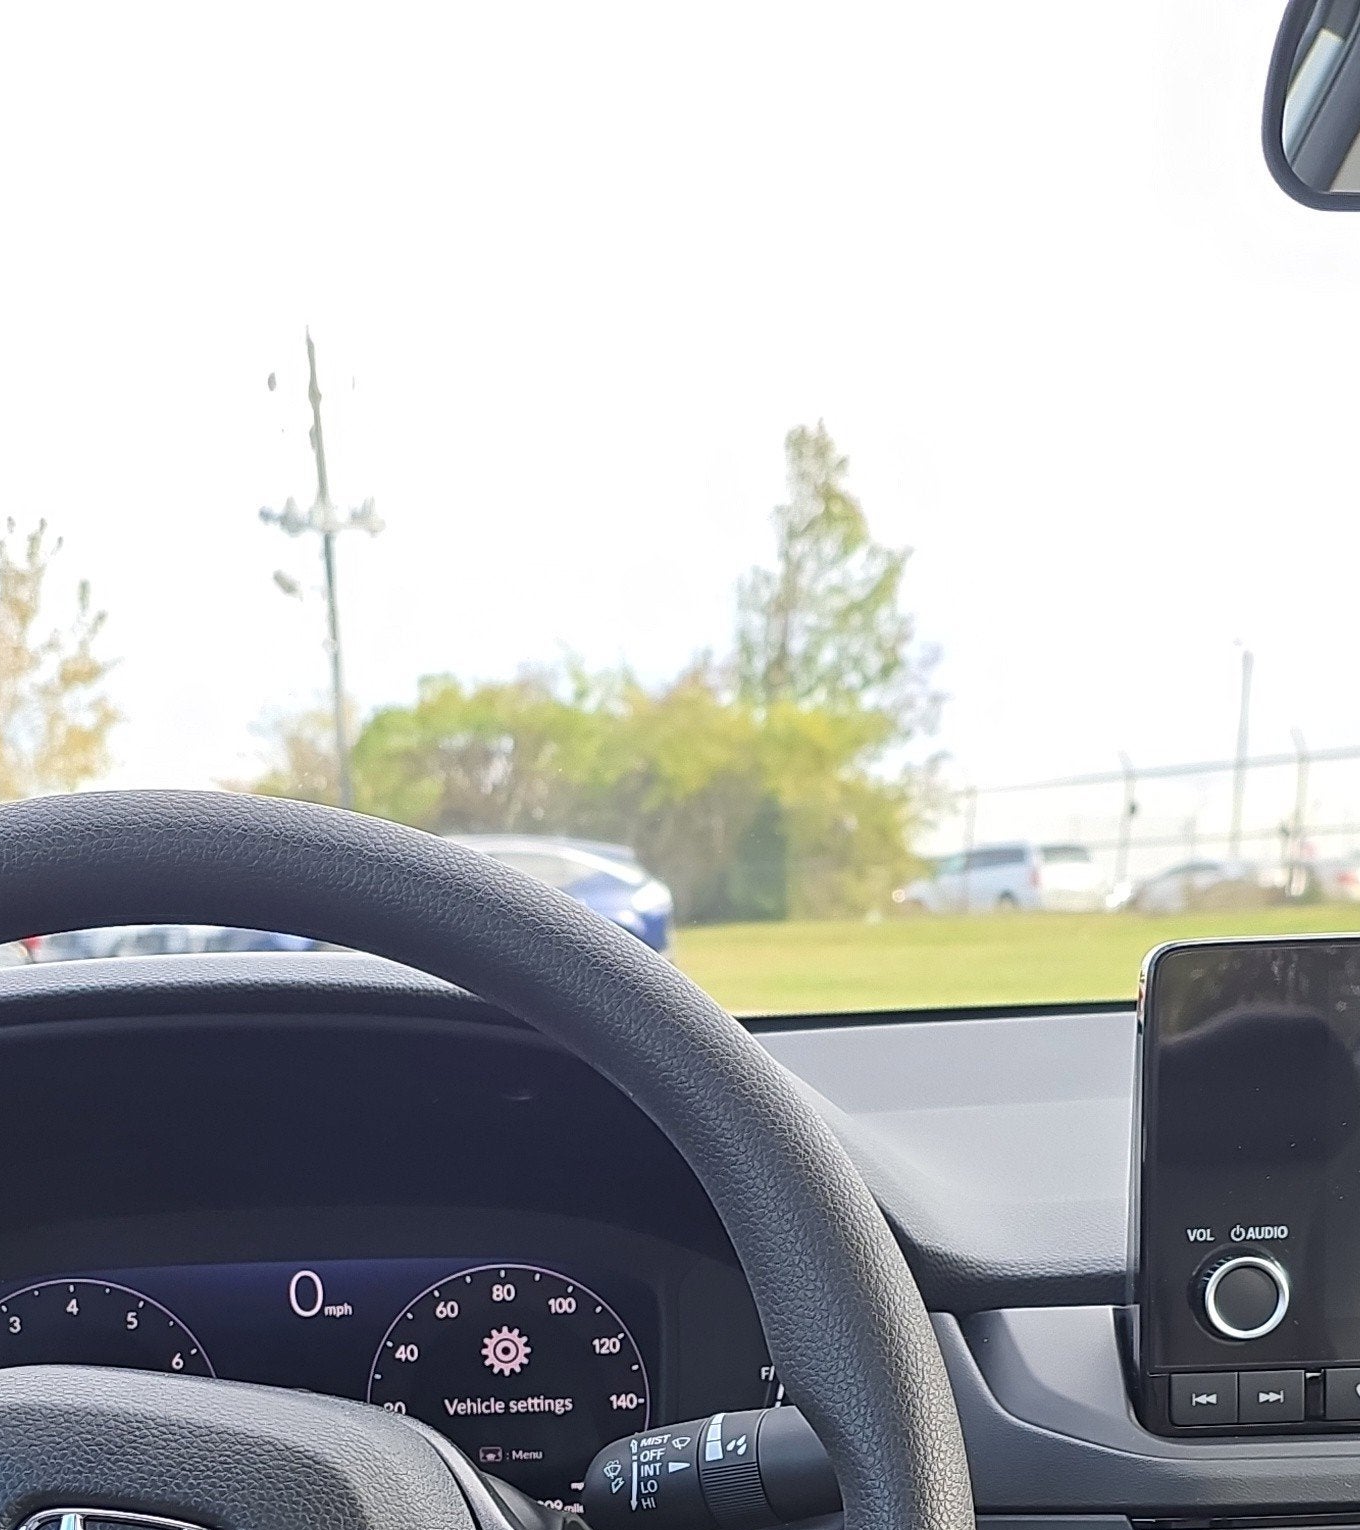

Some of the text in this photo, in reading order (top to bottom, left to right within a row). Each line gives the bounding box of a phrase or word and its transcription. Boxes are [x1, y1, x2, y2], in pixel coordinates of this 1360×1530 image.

[1187, 1225, 1288, 1242] VOL AUDIO
[289, 1269, 353, 1318] 0 mph
[492, 1284, 516, 1301] 80
[66, 1298, 80, 1315] 4
[435, 1301, 459, 1318] 60
[548, 1298, 576, 1314] 100
[8, 1315, 22, 1333] 3
[126, 1312, 138, 1330] 5
[394, 1344, 419, 1362] 40
[592, 1337, 621, 1354] 120
[171, 1352, 184, 1370] 6
[444, 1395, 573, 1416] Vehicle settings
[609, 1393, 638, 1410] 140
[640, 1434, 672, 1448] MIST
[640, 1448, 666, 1462] OFF
[640, 1463, 662, 1477] INT
[640, 1479, 658, 1494] LO
[641, 1496, 657, 1509] HI
